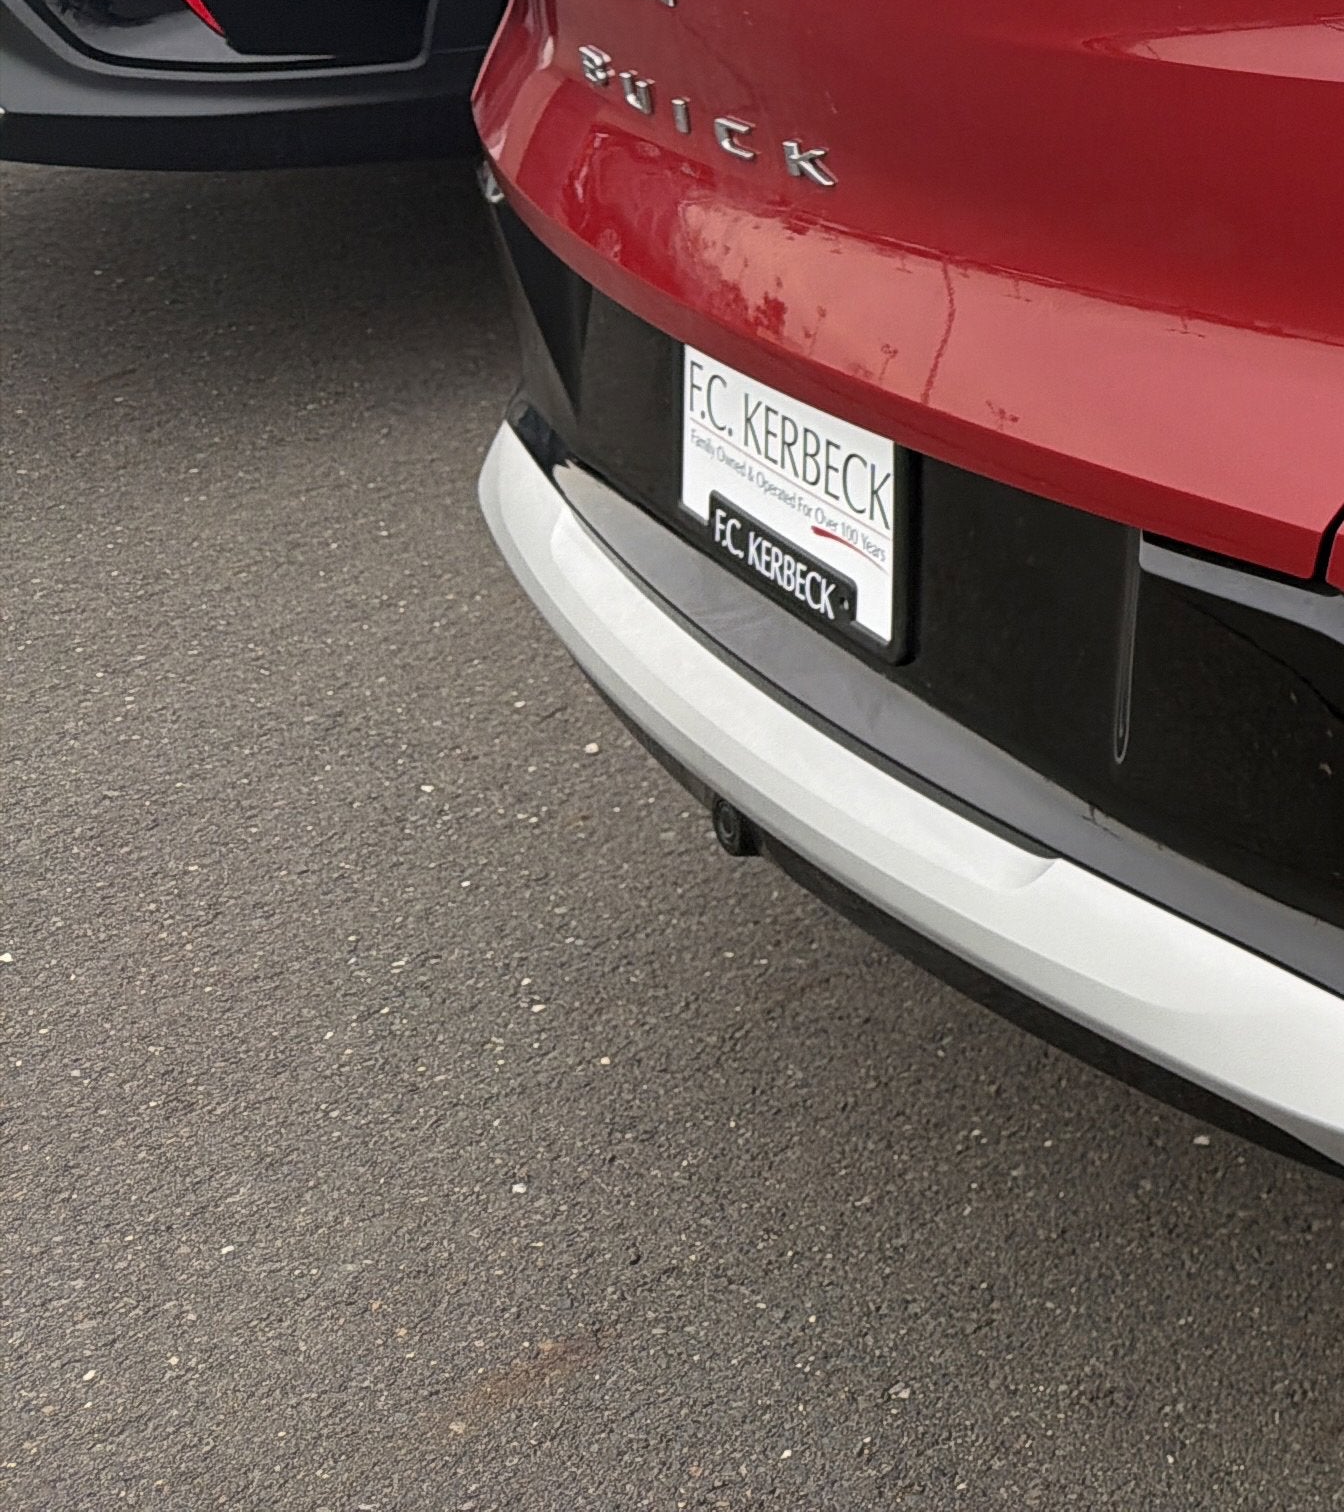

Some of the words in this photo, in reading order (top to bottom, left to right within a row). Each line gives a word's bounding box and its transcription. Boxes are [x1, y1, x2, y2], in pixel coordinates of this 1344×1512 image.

[578, 45, 838, 188] BUICK
[689, 360, 734, 437] F.C.
[743, 392, 892, 530] KERBECK
[713, 508, 745, 560] F.C.
[747, 531, 836, 621] KERBECK
[814, 506, 839, 532] Over
[859, 532, 887, 564] Years
